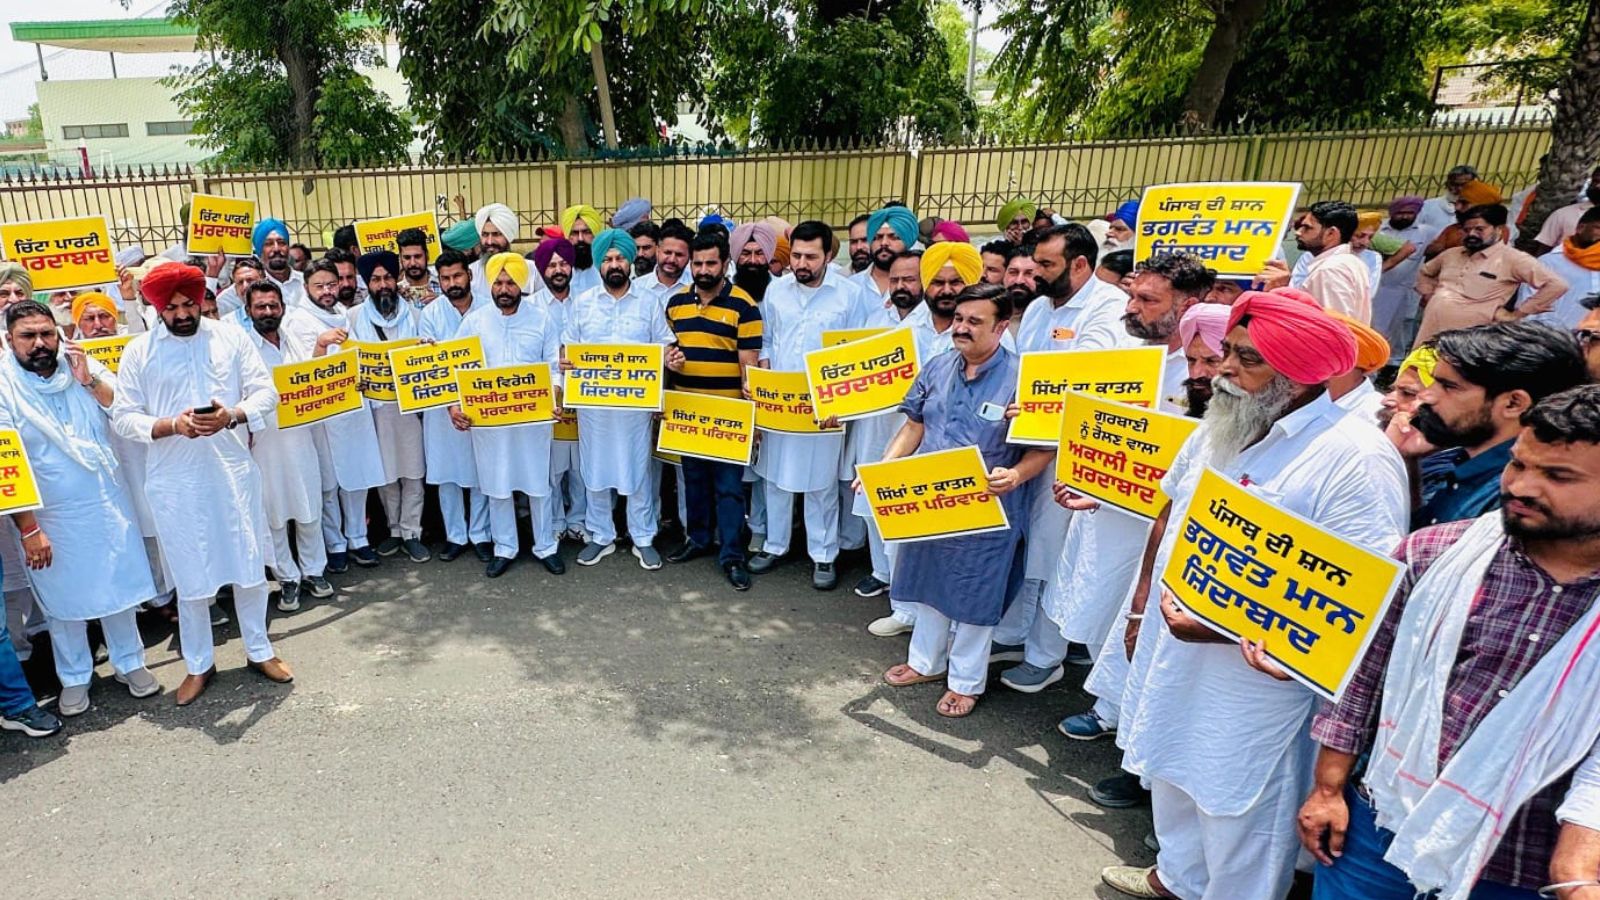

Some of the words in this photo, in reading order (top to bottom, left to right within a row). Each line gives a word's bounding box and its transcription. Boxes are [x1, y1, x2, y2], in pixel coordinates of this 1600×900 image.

[1159, 197, 1201, 212] ਪੰਜਾਬ
[1206, 196, 1226, 211] ਦੀ
[200, 208, 222, 222] ਚਿੱਟਾ
[224, 211, 250, 224] ਪਾਰਟੀ
[1142, 214, 1217, 236] ਭਗਵੰਤ
[1224, 220, 1277, 236] ਮਾਨ
[193, 223, 252, 239] ਮੁਰਦਾਬਾਦ
[14, 239, 49, 254] ਚਿੱਟਾ
[54, 232, 100, 249] ਪਾਰਟੀ
[405, 355, 434, 367] ਪੰਜਾਬ
[437, 350, 449, 361] ਦੀ
[580, 352, 609, 363] ਪੰਜਾਬ
[612, 352, 625, 363] ਦੀ
[820, 363, 856, 380] ਚਿੱਟਾ
[860, 346, 905, 371] ਪਾਰਟੀ
[289, 372, 311, 385] ਪੰਥ
[314, 361, 347, 380] ਵਿਰੋਧੀ
[398, 364, 450, 385] ਭਗਵੰਤ
[472, 378, 493, 389] ਪੰਥ
[496, 373, 536, 388] ਵਿਰੋਧੀ
[571, 364, 622, 380] ਭਗਵੰਤ
[627, 369, 658, 381] ਮਾਨ
[816, 362, 914, 404] ਮੁਰਦਾਬਾਦ
[280, 385, 323, 405] ਸੁਖਬੀਰ
[326, 376, 356, 391] ਬਾਦਲ
[464, 391, 508, 406] ਸੁਖਬੀਰ
[512, 388, 549, 399] ਬਾਦਲ
[580, 381, 646, 398] ਜ਼ਿੰਦਾਬਾਦ
[782, 393, 795, 402] ਦਾ
[1032, 379, 1068, 396] ਸਿੱਖਾਂ
[1095, 381, 1144, 394] ਕਾਤਲ
[295, 392, 346, 416] ਮੁਰਦਾਬਾਦ
[479, 402, 537, 418] ਮੁਰਦਾਬਾਦ
[699, 415, 710, 424] ਦਾ
[713, 418, 743, 429] ਕਾਤਲ
[1094, 410, 1149, 433] ਗੁਰਬਾਣੀ
[666, 422, 699, 435] ਬਾਦਲ
[702, 427, 747, 443] ਪਰਿਵਾਰ
[1068, 440, 1128, 473] ਅਕਾਲੀ
[1126, 437, 1161, 455] ਵਾਲਾ
[876, 484, 908, 501] ਸਿੱਖਾਂ
[911, 484, 928, 496] ਦਾ
[932, 476, 976, 492] ਕਾਤਲ
[1072, 461, 1157, 504] ਮੁਰਦਾਬਾਦ
[876, 502, 920, 517] ਬਾਦਲ
[923, 492, 996, 510] ਪਰਿਵਾਰ
[1209, 499, 1262, 541] ਪੰਜਾਬ
[1265, 533, 1294, 559] ਦੀ
[1296, 549, 1353, 587] ਸ਼ਾਨ
[1183, 516, 1278, 589] ਭਗਵੰਤ
[1282, 577, 1366, 635] ਮਾਨ
[1180, 554, 1321, 655] ਜ਼ਿੰਦਾਬਾਦ
